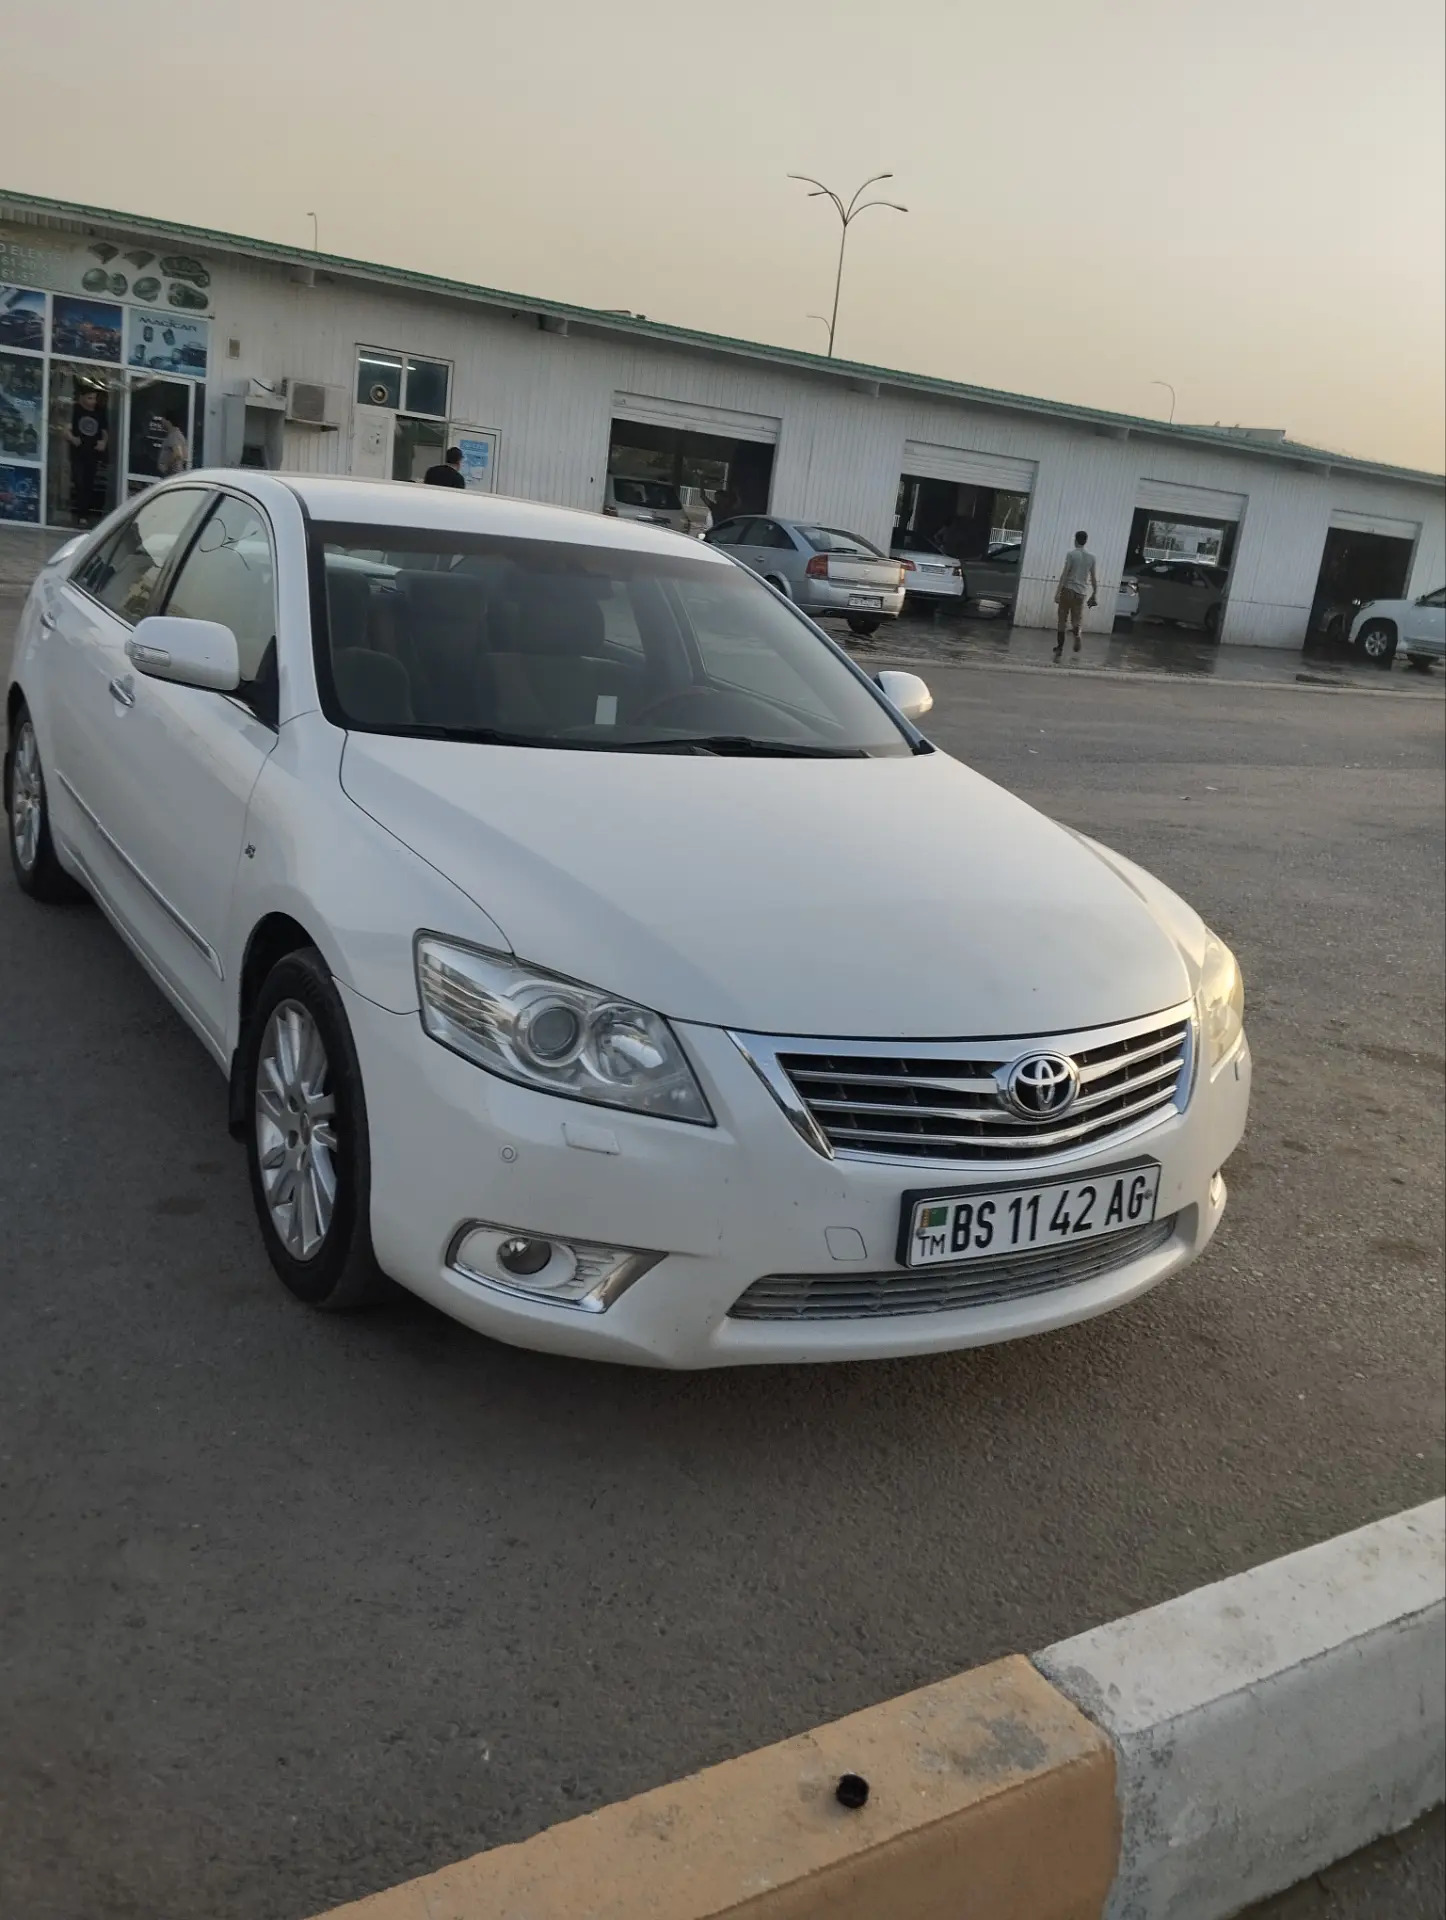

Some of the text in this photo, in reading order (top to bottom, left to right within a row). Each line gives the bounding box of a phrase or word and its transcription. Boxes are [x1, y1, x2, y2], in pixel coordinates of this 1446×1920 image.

[951, 1175, 1146, 1253] BS 11 42 AG
[919, 1233, 946, 1257] TM
